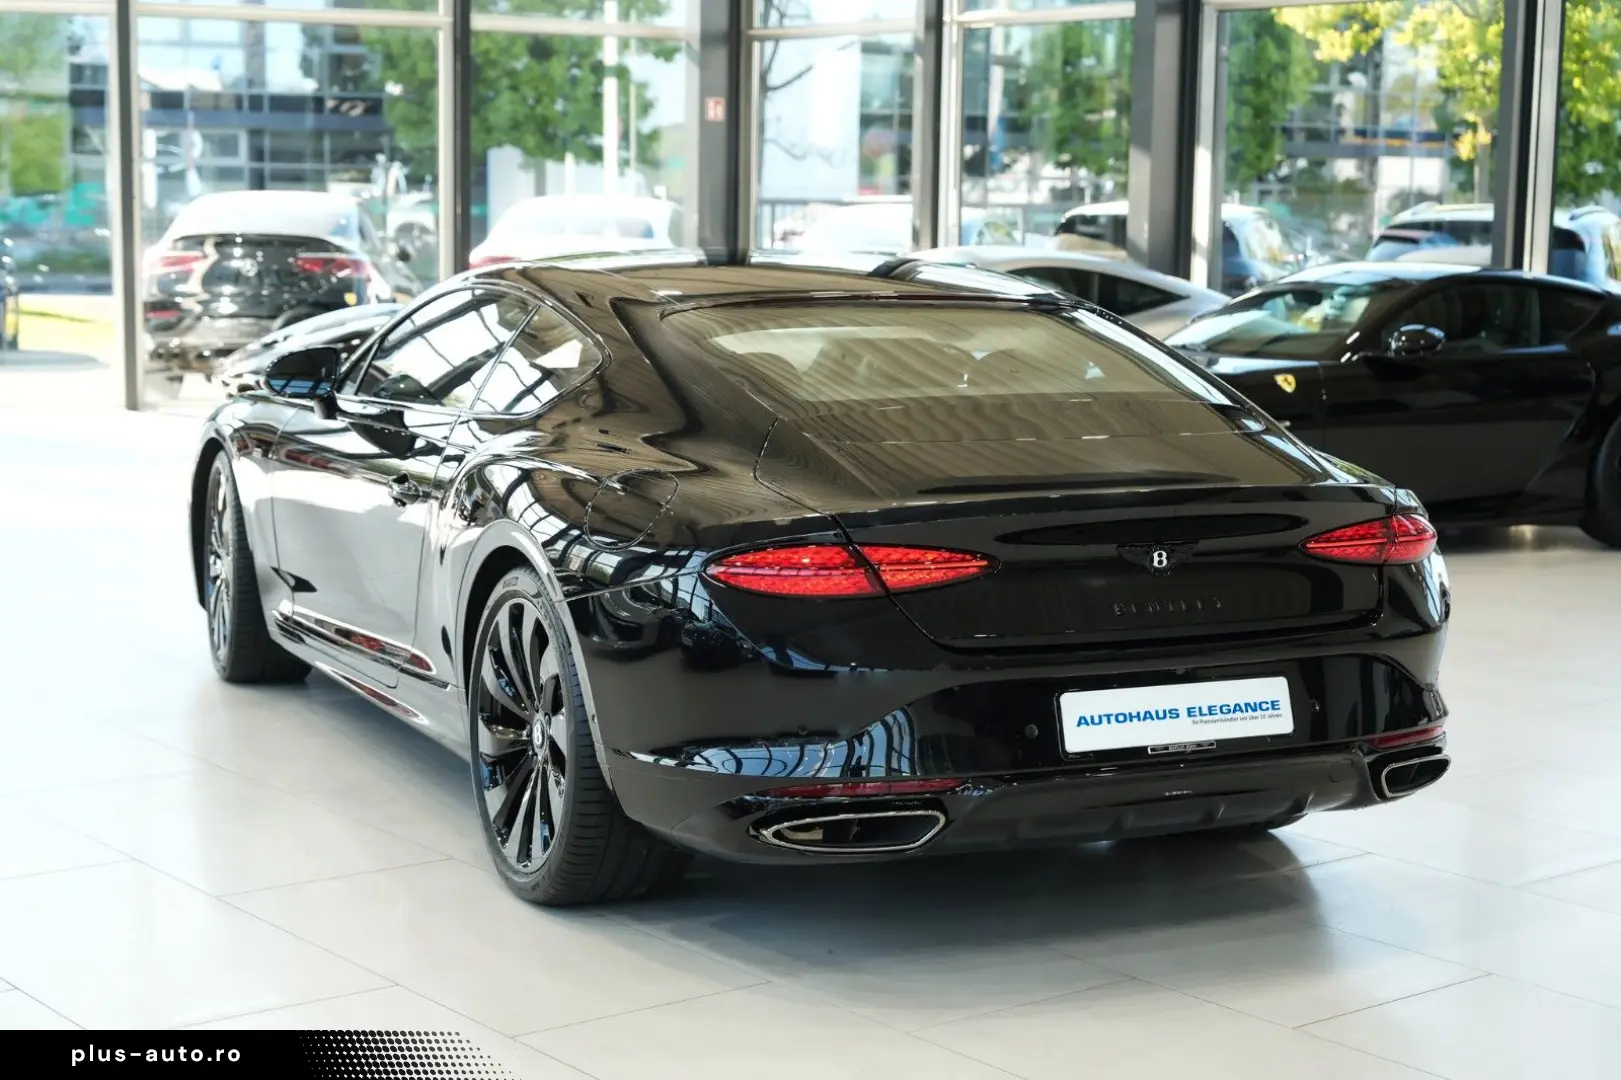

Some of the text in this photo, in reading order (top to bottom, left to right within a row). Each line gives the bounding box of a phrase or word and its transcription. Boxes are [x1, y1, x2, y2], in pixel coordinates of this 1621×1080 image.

[1152, 550, 1168, 568] B
[1076, 700, 1281, 727] AUTOHAUS ELEGANCE
